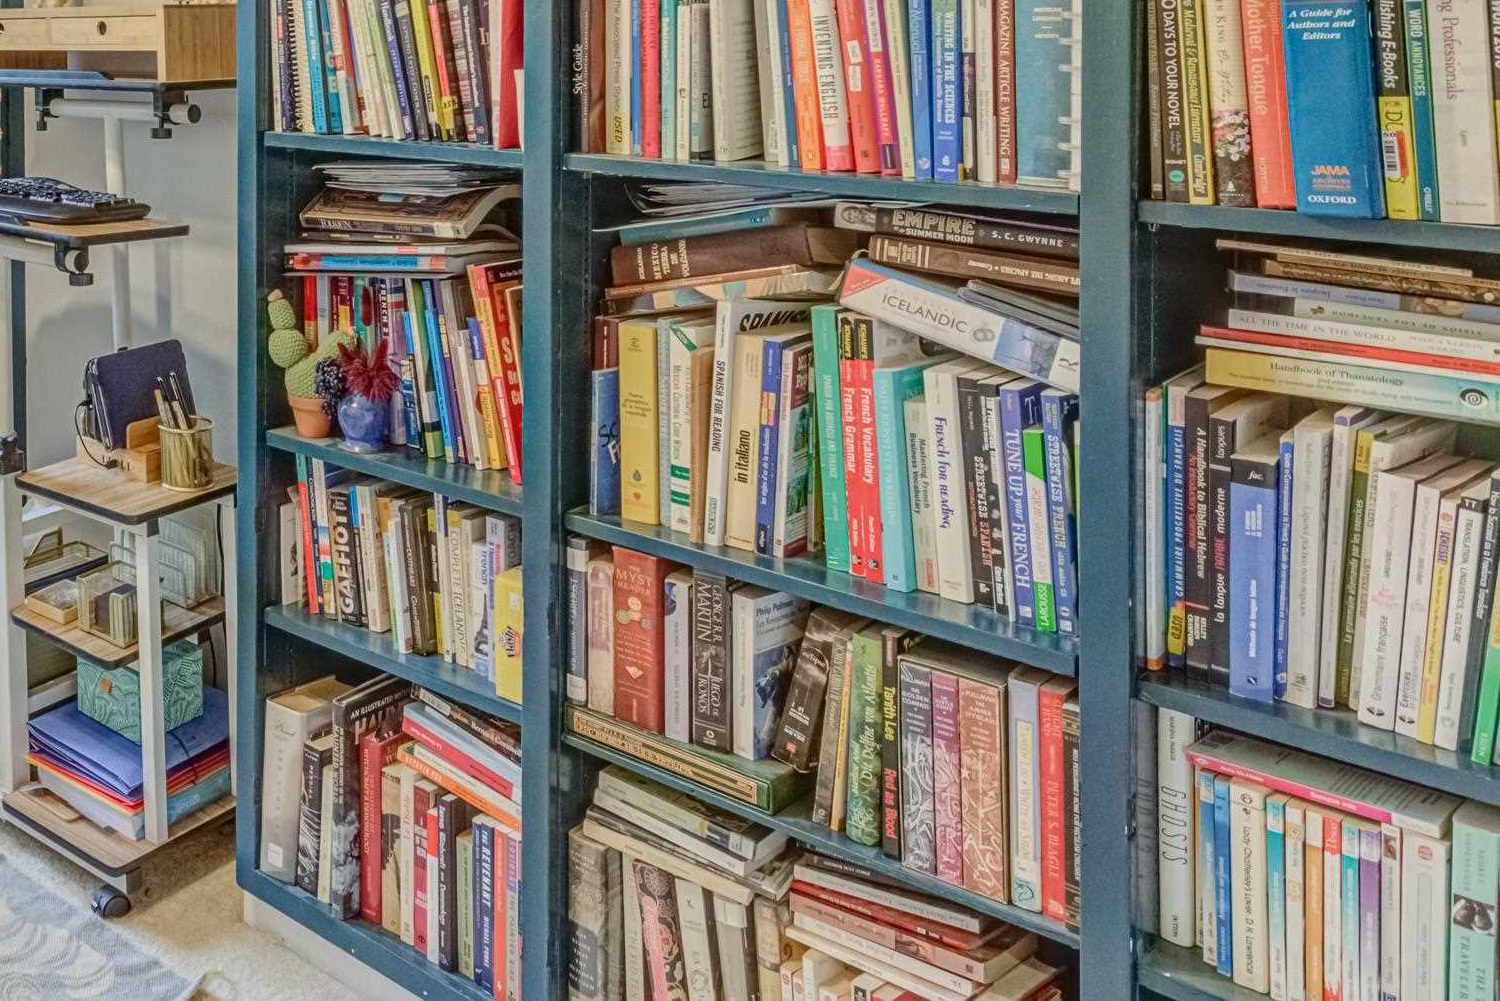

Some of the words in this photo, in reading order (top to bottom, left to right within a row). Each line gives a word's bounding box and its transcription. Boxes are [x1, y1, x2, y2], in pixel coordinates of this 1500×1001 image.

[306, 1, 315, 37] Grammar
[380, 2, 394, 42] Handbook
[944, 11, 956, 49] WRITING
[1000, 0, 1011, 56] MAGAZINE
[1164, 11, 1176, 39] DAYS
[1217, 16, 1228, 41] KING
[1288, 19, 1329, 29] Authors
[1332, 19, 1355, 28] and
[1409, 9, 1423, 37] WORD
[310, 39, 318, 60] Bible
[814, 15, 834, 69] INVENTING
[944, 51, 955, 61] IN
[1164, 42, 1176, 56] TO
[1442, 17, 1464, 99] Professionals
[944, 63, 955, 81] THE
[1000, 60, 1010, 103] ARTICLE
[1166, 58, 1178, 89] YOUR
[1382, 40, 1398, 89] E-Books
[1411, 41, 1426, 96] ANNOYANCES
[819, 74, 839, 119] ENGLISH
[944, 83, 955, 124] SCIENCES
[1250, 55, 1272, 115] Tongue
[1167, 91, 1181, 128] NOVEL
[614, 115, 622, 143] USED
[1000, 107, 1011, 155] WRITING
[1308, 195, 1356, 205] OXFORD
[892, 209, 976, 235] EMPIRE
[905, 229, 944, 241] SUMMER
[946, 233, 974, 244] MOON
[992, 230, 1001, 239] S.
[1004, 231, 1014, 241] C.
[1018, 235, 1064, 247] GWYNNE
[882, 293, 967, 335] ICELANDIC
[715, 361, 726, 395] SPANISH
[714, 397, 724, 411] FOR
[844, 387, 856, 421] French
[862, 387, 872, 423] French
[712, 413, 723, 452] READING
[844, 425, 856, 472] Grammar
[1174, 429, 1184, 469] FRANÇAIS
[1197, 427, 1206, 435] A
[736, 430, 751, 471] italiano
[861, 427, 875, 485] Vocabulary
[1006, 429, 1022, 472] TUNE
[1048, 435, 1064, 503] STREETWISE
[1197, 446, 1206, 487] Handbook
[734, 473, 750, 483] in
[974, 455, 989, 517] STREETWISE
[1009, 475, 1024, 495] UP
[1174, 471, 1184, 485] DU
[1197, 491, 1206, 500] to
[1012, 498, 1024, 519] your
[1052, 505, 1067, 548] FRENCH
[1174, 487, 1184, 543] PROGRESSIVE
[1197, 503, 1206, 539] Biblical
[450, 529, 462, 588] COMPLETE
[978, 522, 993, 566] SPANISH
[1012, 522, 1030, 588] FRENCH
[1197, 542, 1206, 579] Hebrew
[332, 511, 355, 615] GAFFIOT
[616, 569, 652, 586] MYST
[1174, 548, 1184, 597] GRAMMAIRE
[696, 581, 711, 643] MARTIN
[1037, 583, 1050, 627] LAROUSSE
[1374, 615, 1390, 652] française
[1371, 655, 1386, 701] Grammaire
[884, 686, 895, 719] Tanith
[884, 722, 896, 741] Lee
[884, 767, 896, 789] Red
[885, 791, 894, 805] as
[885, 807, 897, 839] Blood
[1160, 785, 1187, 865] GHOSTS
[1242, 826, 1252, 845] Lady
[481, 847, 492, 907] REVENANT
[1243, 849, 1256, 892] Chatterley's
[1244, 893, 1254, 913] Lover
